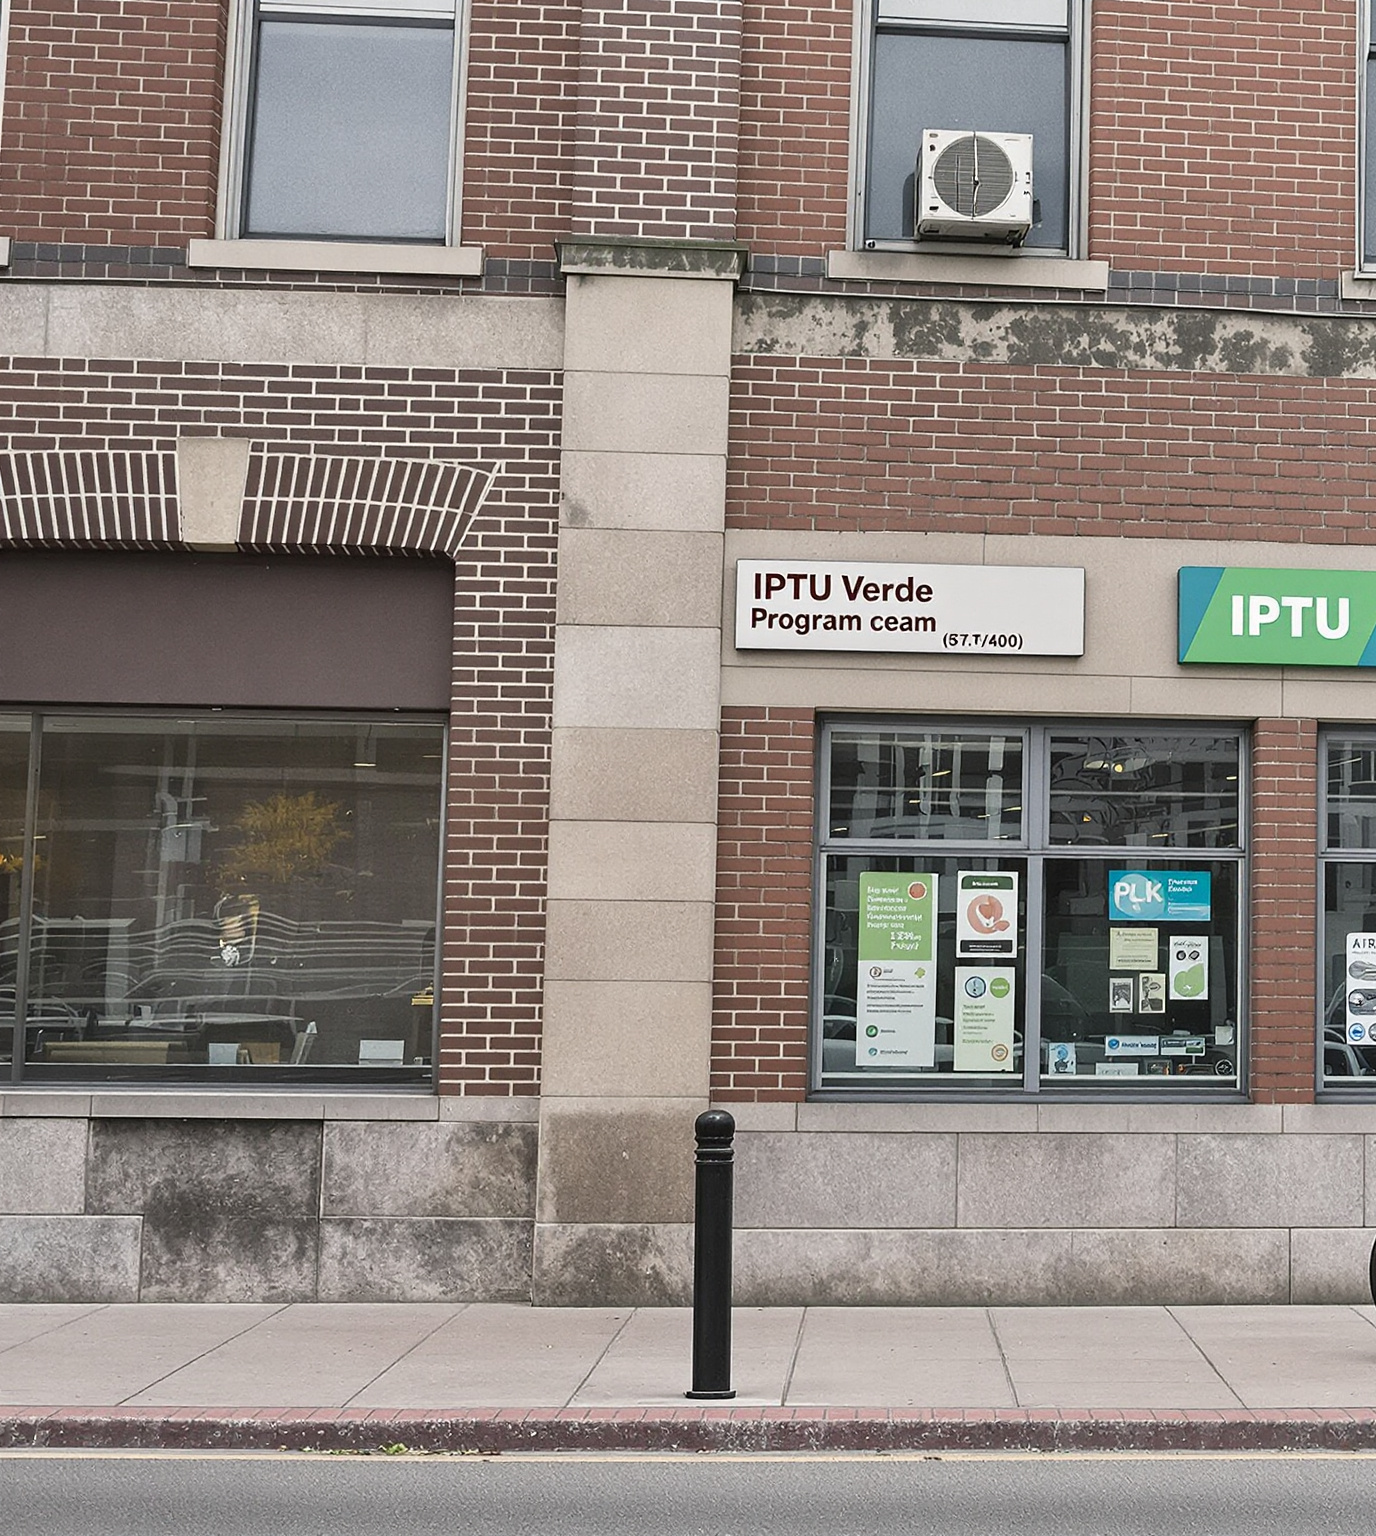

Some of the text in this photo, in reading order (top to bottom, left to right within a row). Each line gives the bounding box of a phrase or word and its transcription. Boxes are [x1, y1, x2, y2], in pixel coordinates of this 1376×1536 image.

[753, 572, 934, 603] IPTU Verde
[750, 607, 937, 635] Program ceam
[1231, 595, 1350, 640] IPTU
